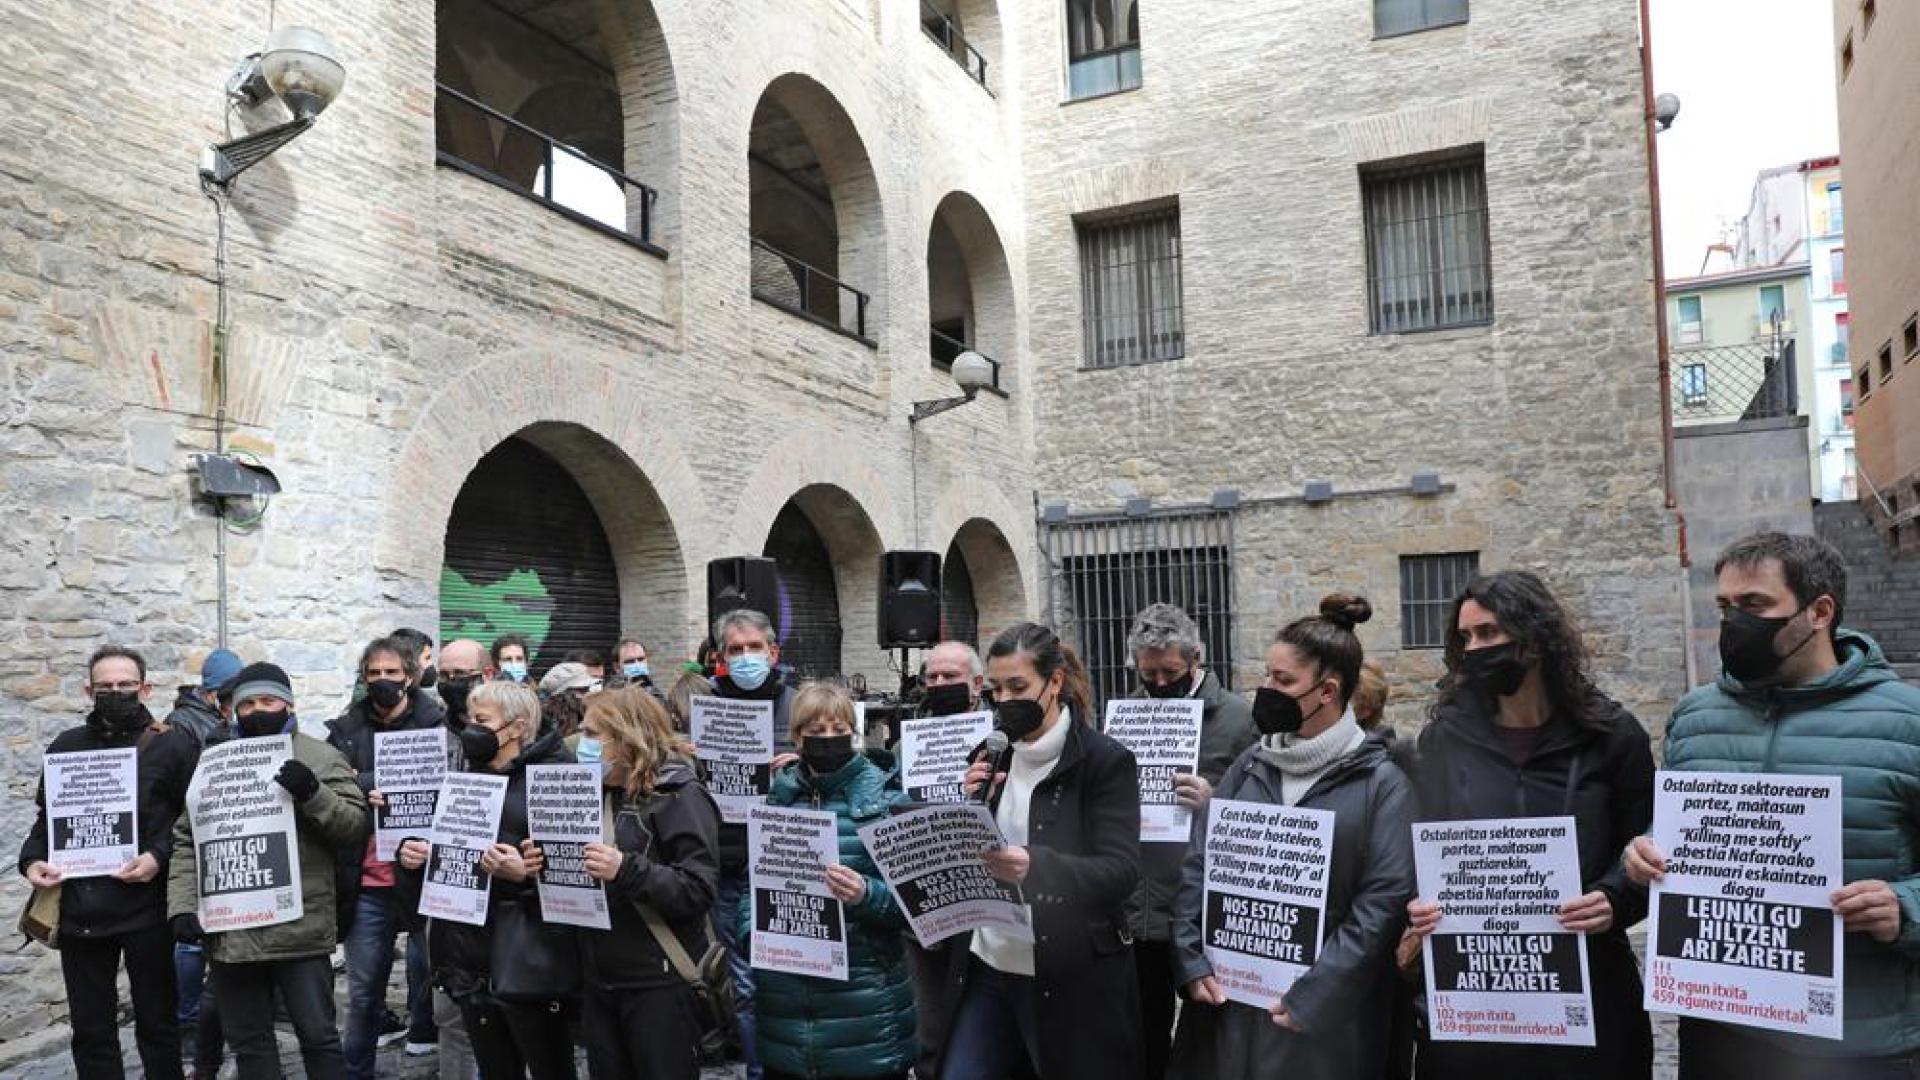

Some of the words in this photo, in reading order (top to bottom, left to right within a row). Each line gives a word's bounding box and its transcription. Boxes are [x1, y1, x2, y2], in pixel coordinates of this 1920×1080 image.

[1663, 778, 1738, 794] Ostalaritza
[1740, 781, 1830, 799] sektorearen
[1682, 797, 1733, 813] partez,
[1736, 798, 1805, 815] maitasun
[874, 826, 897, 837] Con
[927, 811, 938, 821] el
[1221, 807, 1239, 820] Con
[1240, 810, 1266, 824] todo
[1269, 813, 1280, 826] el
[1281, 815, 1319, 831] cariño
[1700, 813, 1785, 832] guztiarekin,
[1213, 823, 1229, 835] del
[1230, 827, 1264, 840] sector
[1265, 828, 1323, 849] hostelero,
[1420, 827, 1487, 842] Ostalaritza
[1489, 825, 1566, 839] sektorearen
[1680, 827, 1731, 847] "Killing
[1733, 832, 1757, 845] me
[246, 837, 267, 854] GU
[873, 839, 891, 850] del
[1208, 838, 1264, 857] dedicamos
[1265, 845, 1277, 858] la
[1280, 849, 1325, 865] canción
[1441, 843, 1484, 859] partez,
[1488, 842, 1546, 854] maitasun
[1459, 857, 1531, 872] guztiarekin,
[1674, 844, 1727, 861] abestia
[1728, 848, 1815, 868] Nafarroako
[219, 869, 273, 890] ZARETE
[1248, 862, 1266, 873] me
[1310, 869, 1324, 880] al
[1488, 874, 1507, 885] me
[1745, 866, 1827, 886] eskaintzen
[1209, 869, 1255, 888] Gobierno
[1257, 877, 1271, 890] de
[1273, 879, 1323, 898] Navarra
[1722, 881, 1765, 900] diogu
[810, 897, 824, 911] GU
[1438, 888, 1482, 901] abestia
[1486, 887, 1559, 900] Nafarroako
[1223, 896, 1248, 915] NOS
[1252, 901, 1298, 925] ESTÁIS
[1687, 897, 1764, 924] LEUNKI
[1770, 907, 1802, 928] GU
[1225, 914, 1292, 940] MATANDO
[1483, 918, 1520, 932] diogu
[1699, 919, 1788, 948] HILTZEN
[1214, 929, 1302, 961] SUAVEMENTE
[1456, 936, 1522, 954] LEUNKI
[1526, 935, 1552, 954] GU
[1469, 953, 1542, 972] HILTZEN
[1681, 938, 1717, 961] ARI
[1723, 943, 1806, 972] ZARETE
[1456, 972, 1485, 990] ARI
[1491, 972, 1560, 991] ZARETE
[1654, 975, 1675, 989] 102
[1678, 980, 1709, 997] egun
[1653, 990, 1674, 1004] 459
[1678, 994, 1723, 1011] egunez
[1728, 1001, 1808, 1025] murrizketak
